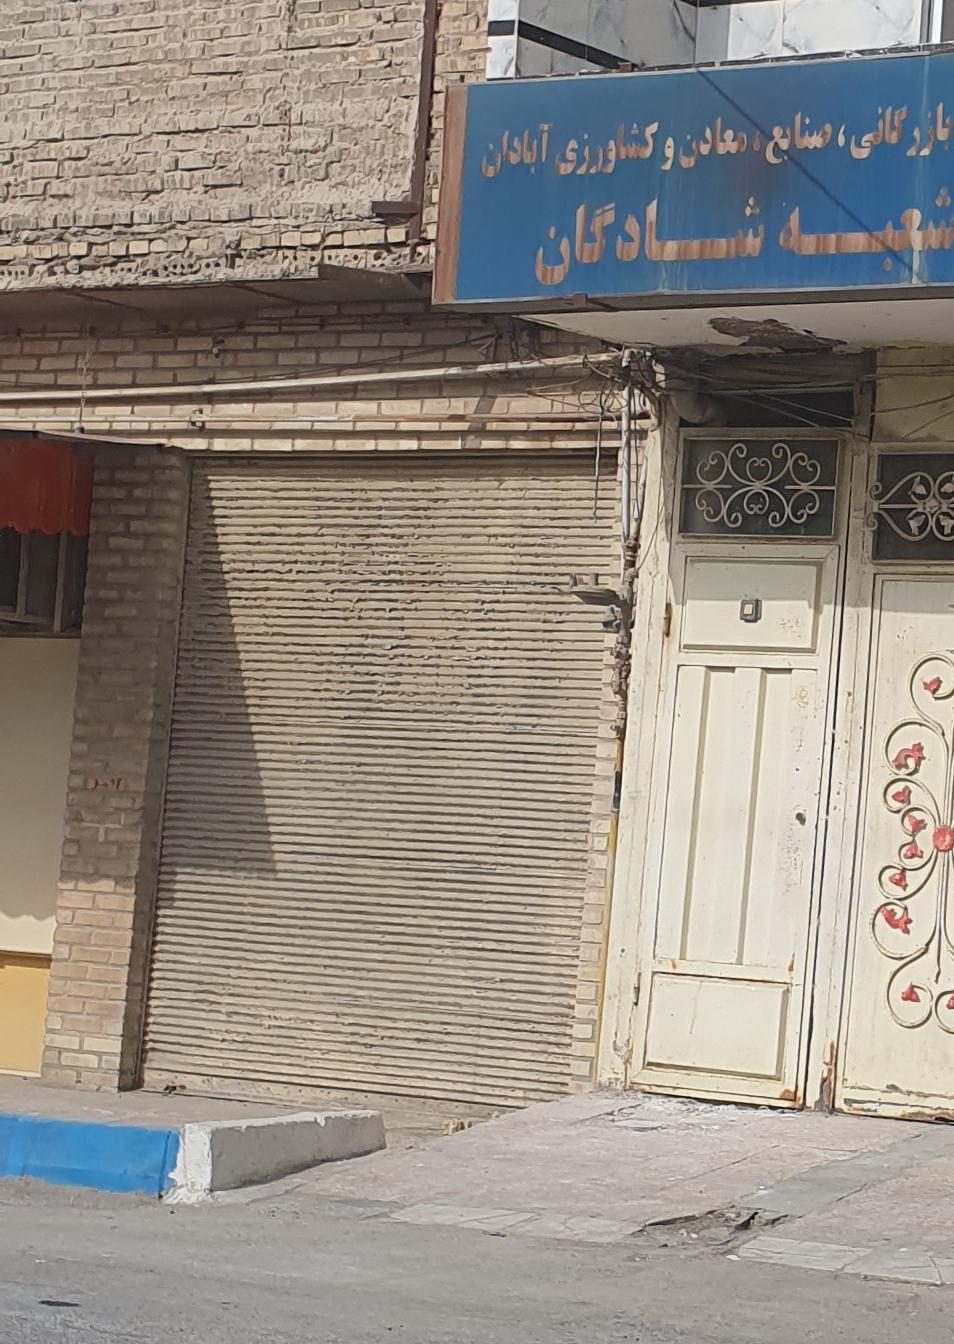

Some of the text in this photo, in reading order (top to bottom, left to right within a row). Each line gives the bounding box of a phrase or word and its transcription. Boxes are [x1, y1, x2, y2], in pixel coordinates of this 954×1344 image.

[481, 122, 552, 178] آبادان
[555, 121, 659, 176] کشاورزی
[660, 137, 675, 171] و
[679, 116, 747, 169] معادن
[535, 194, 766, 286] شادگان
